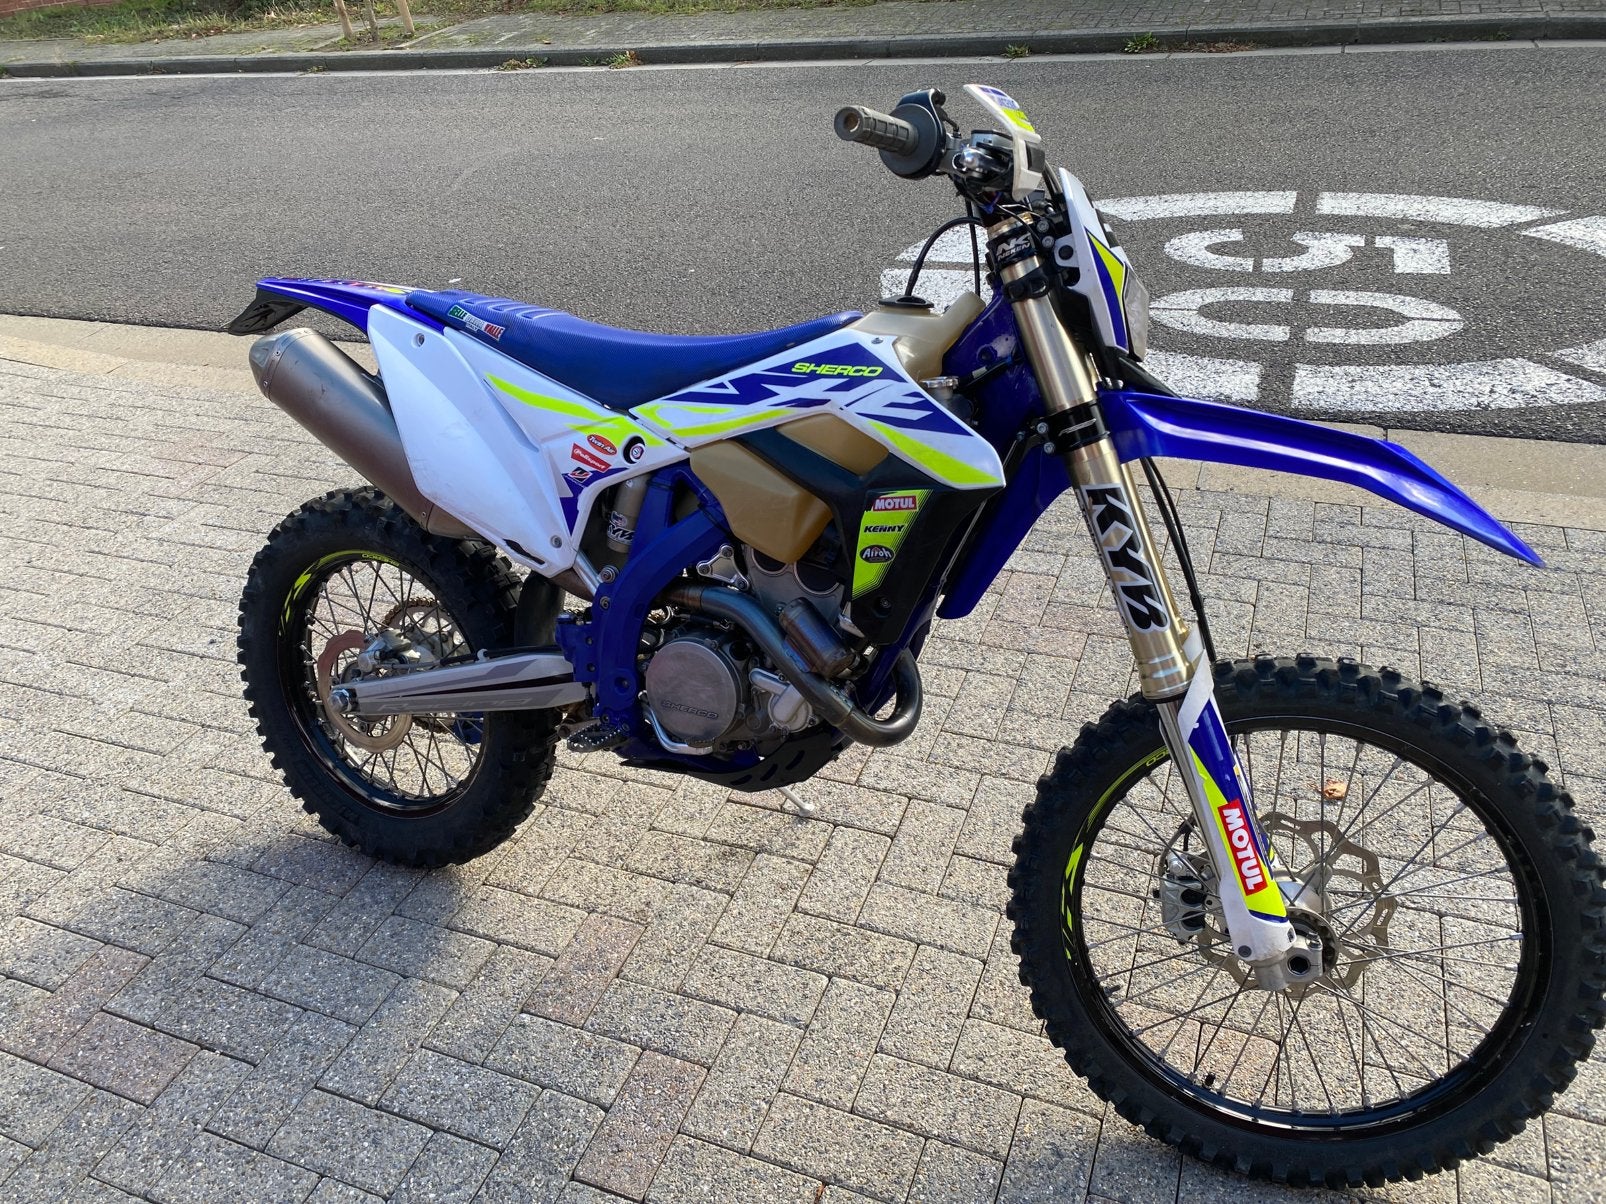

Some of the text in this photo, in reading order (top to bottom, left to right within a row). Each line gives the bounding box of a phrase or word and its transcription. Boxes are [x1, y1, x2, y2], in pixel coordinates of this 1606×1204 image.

[1149, 228, 1464, 345] 50
[791, 363, 884, 377] SHERCO
[573, 448, 606, 470] Polisport
[874, 497, 915, 510] MOTUL
[863, 525, 905, 533] KENNY
[862, 547, 892, 559] Airoh
[1084, 485, 1169, 632] KYB
[661, 700, 719, 719] SHERCO
[1222, 807, 1264, 890] MOTUL
